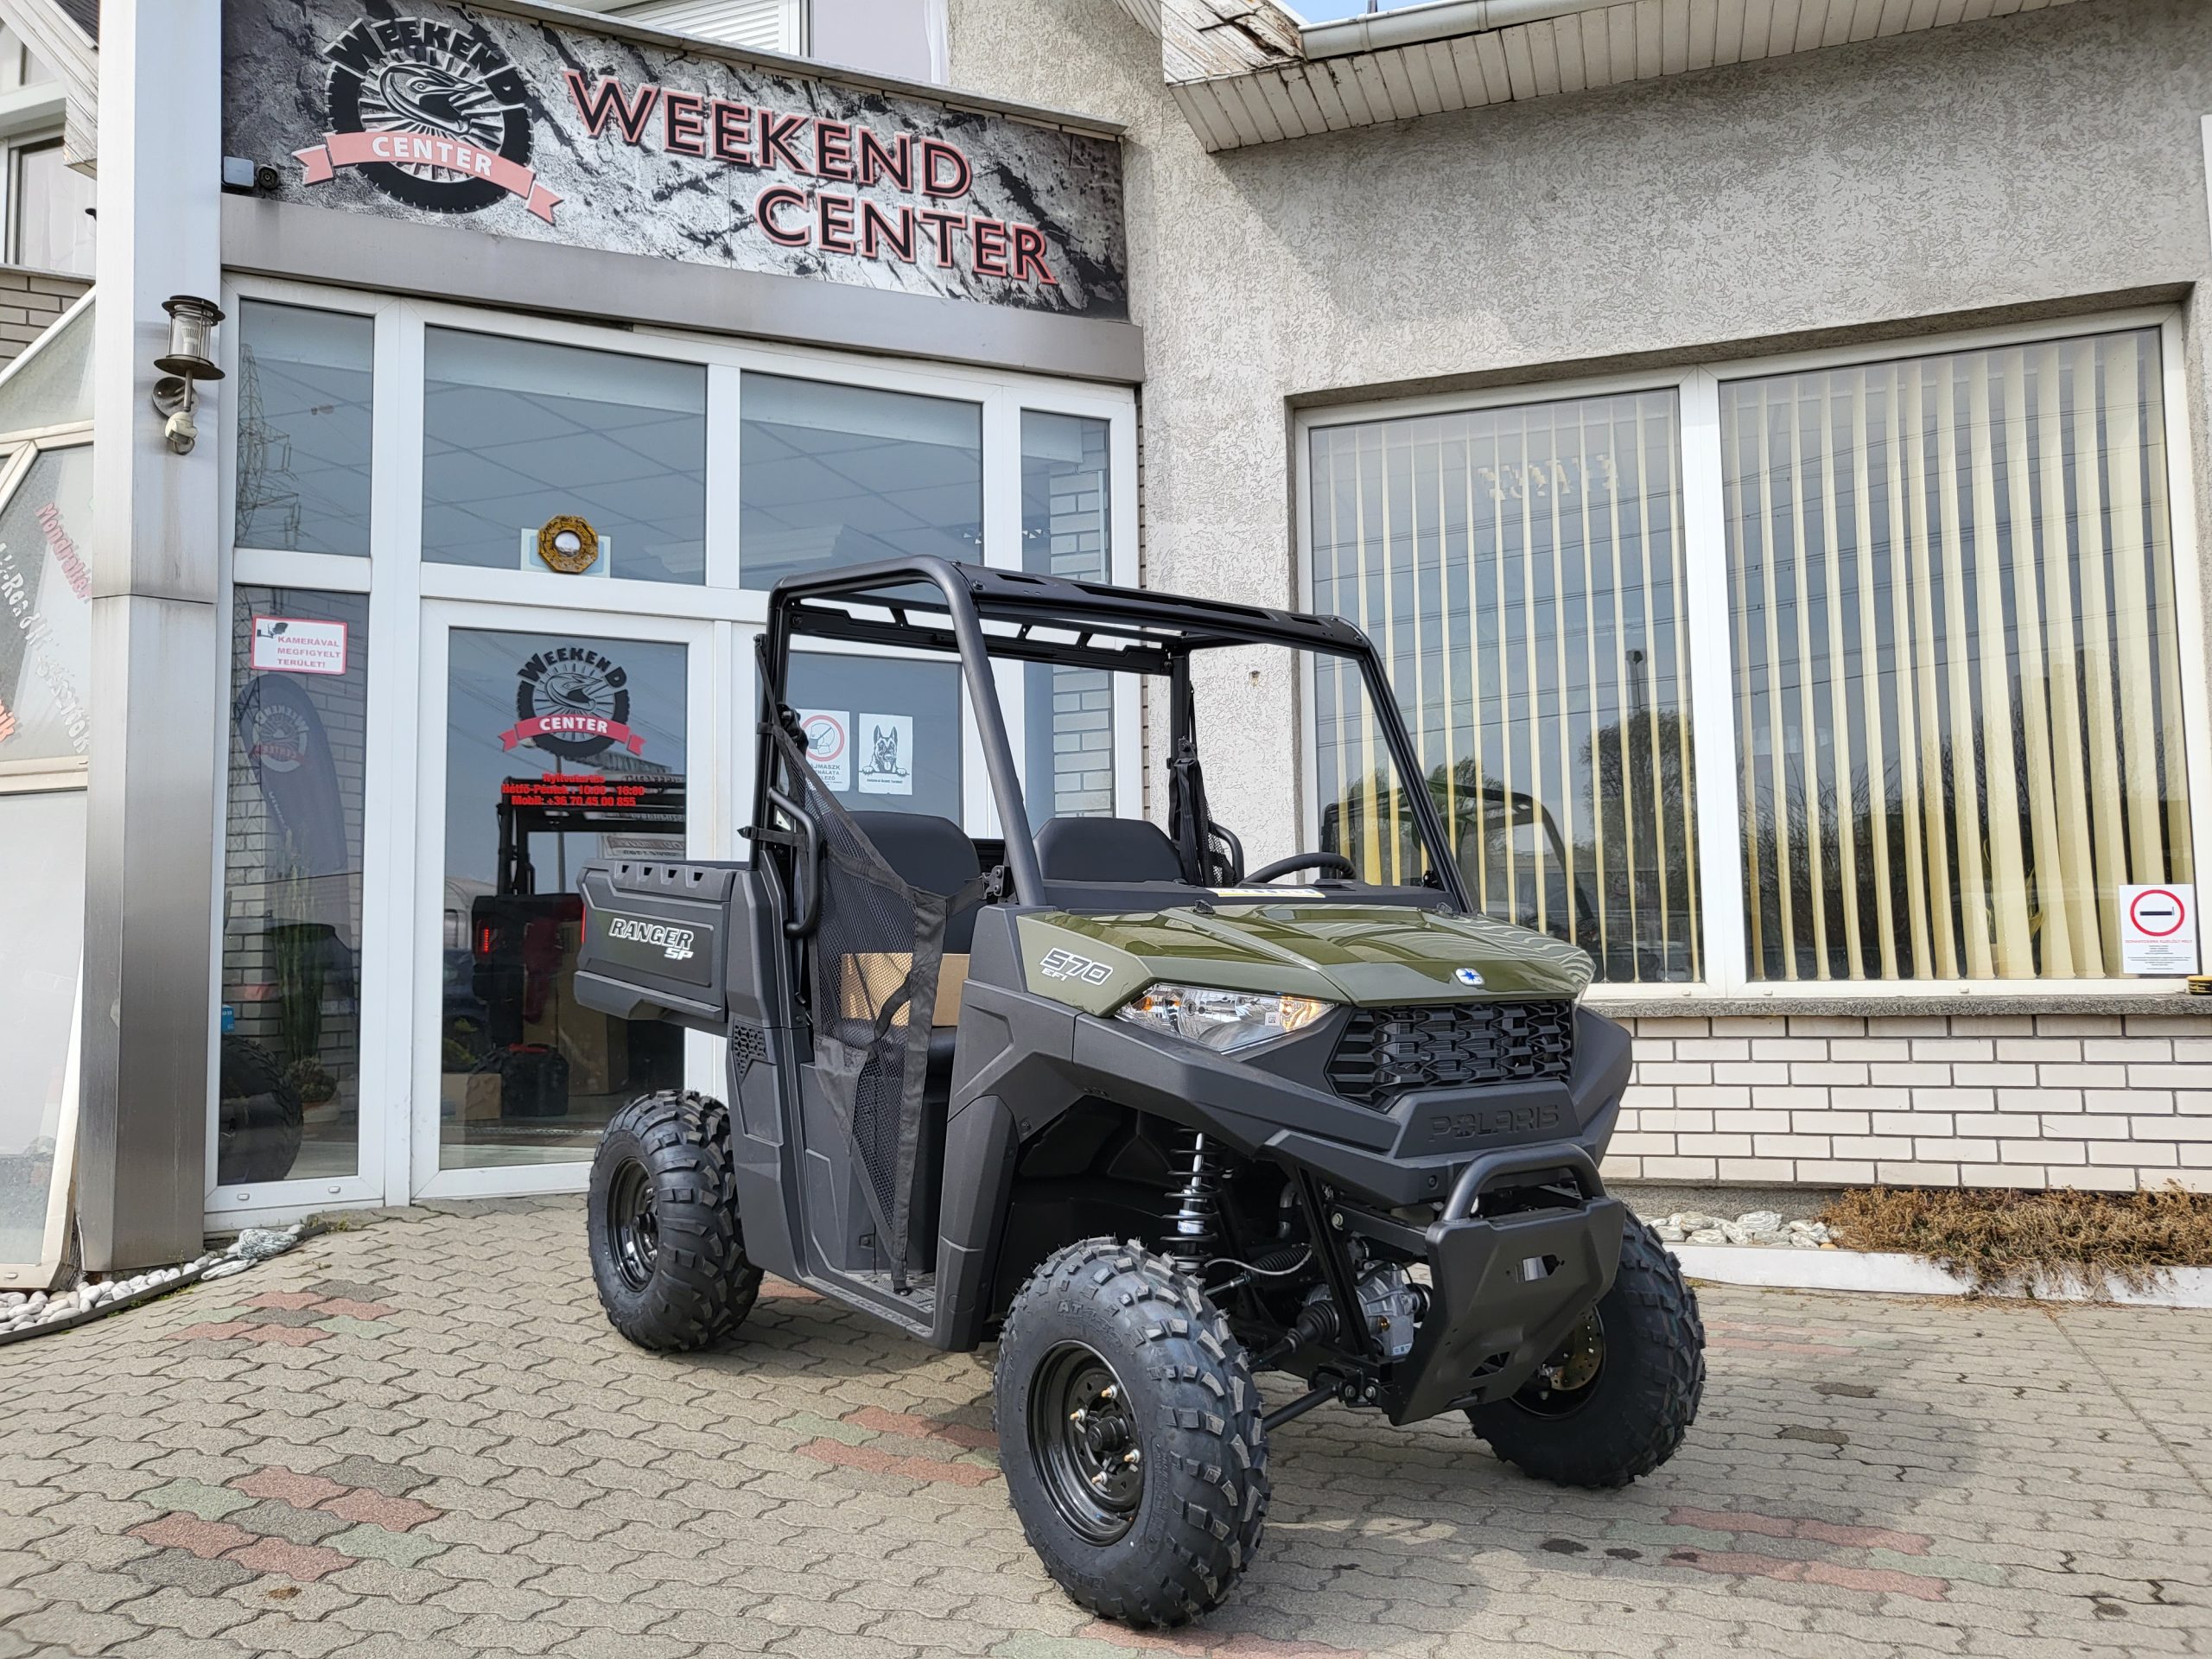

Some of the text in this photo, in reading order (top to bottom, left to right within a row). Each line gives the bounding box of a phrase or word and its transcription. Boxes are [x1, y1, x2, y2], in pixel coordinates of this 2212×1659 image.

[322, 17, 526, 106] WEEKEND
[563, 67, 973, 200] WEEKEND
[372, 136, 493, 176] CENTER
[756, 185, 1058, 285] CENTER
[277, 636, 340, 647] KAMERÁVAL
[277, 647, 341, 658] MEGFIGYELT
[277, 658, 326, 668] TERÜLET!
[517, 647, 627, 688] WEEKEND
[539, 716, 608, 734] CENTER
[608, 918, 694, 950] RANGER
[664, 947, 694, 960] SP
[1039, 947, 1113, 986] 570
[1041, 967, 1068, 982] EFI
[1428, 1104, 1560, 1142] POLARIS
